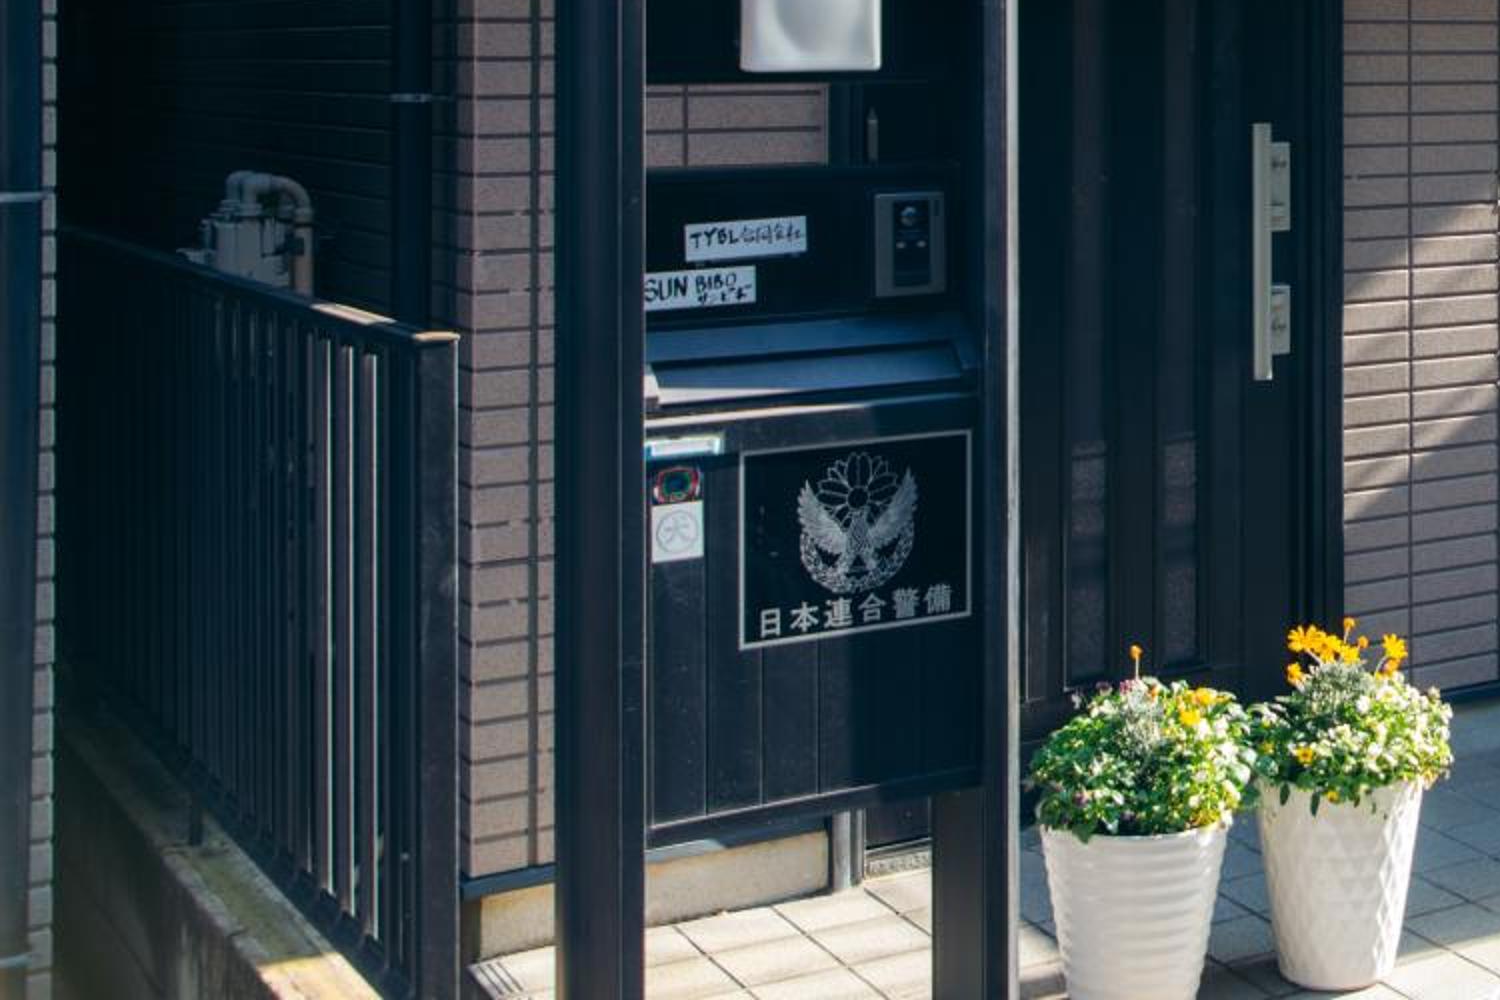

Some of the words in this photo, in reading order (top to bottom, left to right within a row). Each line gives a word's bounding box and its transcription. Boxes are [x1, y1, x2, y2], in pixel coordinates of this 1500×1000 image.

[644, 275, 688, 302] SUN
[695, 272, 737, 294] BIBO
[760, 583, 953, 639] 日本連合警備
